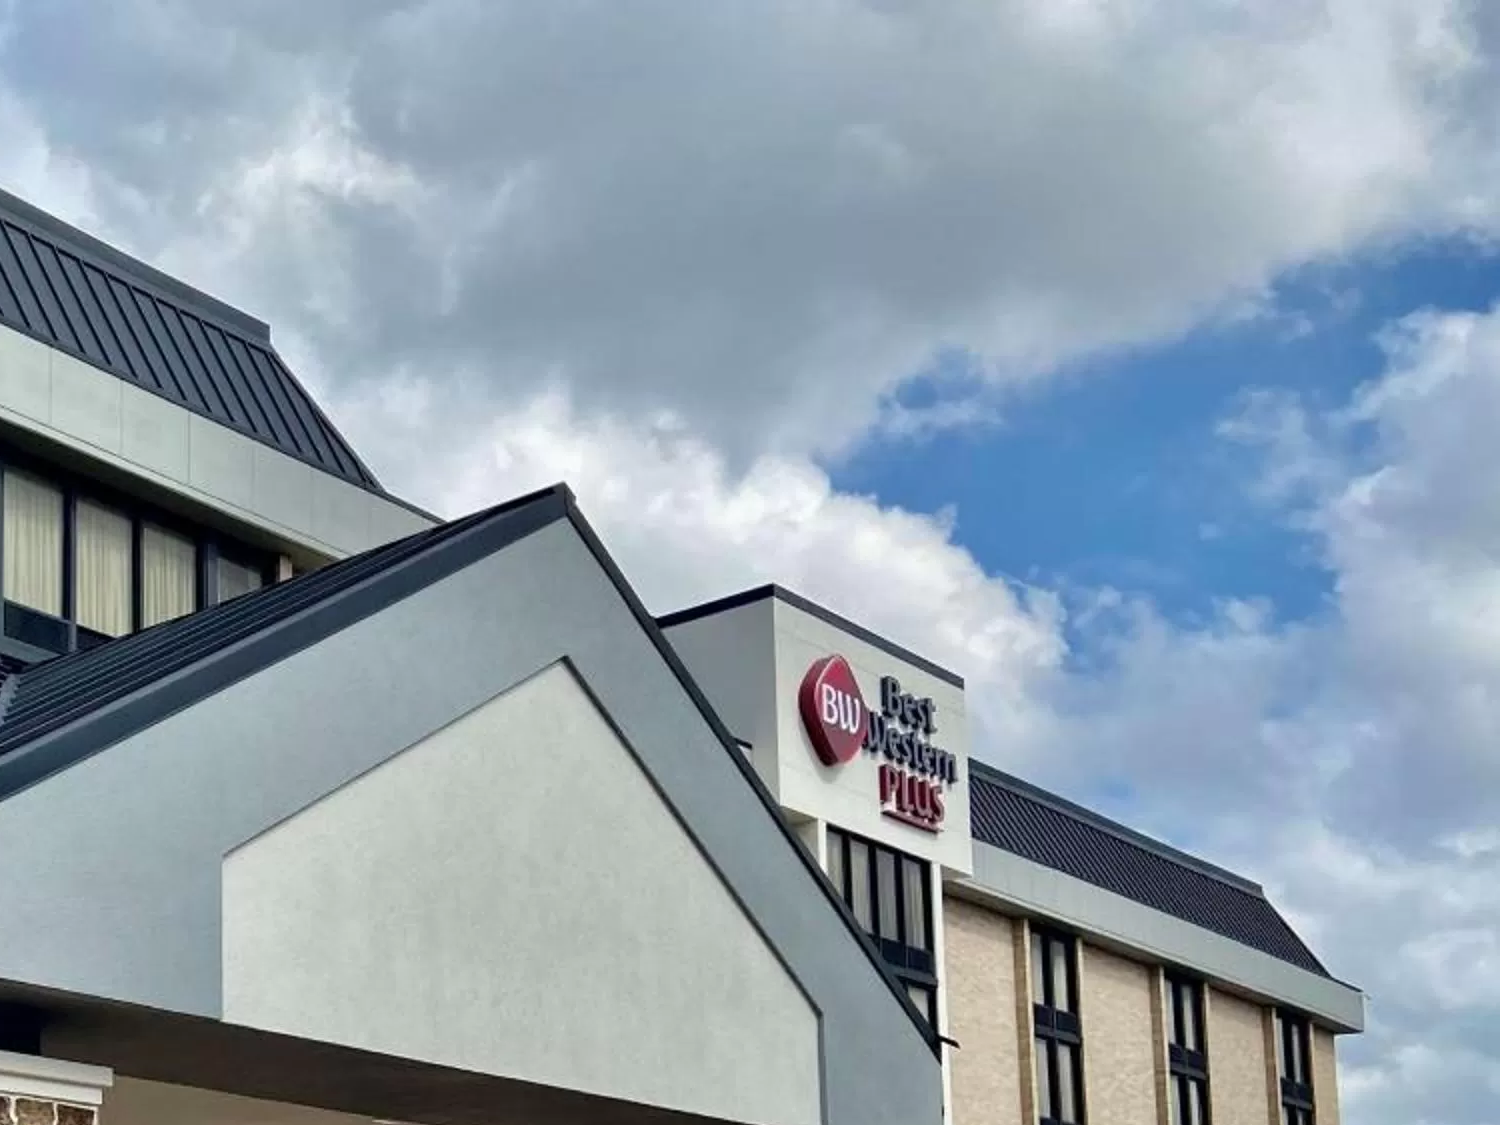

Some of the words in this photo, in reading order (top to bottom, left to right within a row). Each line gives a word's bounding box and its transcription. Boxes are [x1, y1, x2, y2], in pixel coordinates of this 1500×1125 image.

[821, 683, 861, 735] BW
[881, 675, 938, 735] Best
[863, 711, 958, 784] Western
[879, 763, 945, 822] PLUS
